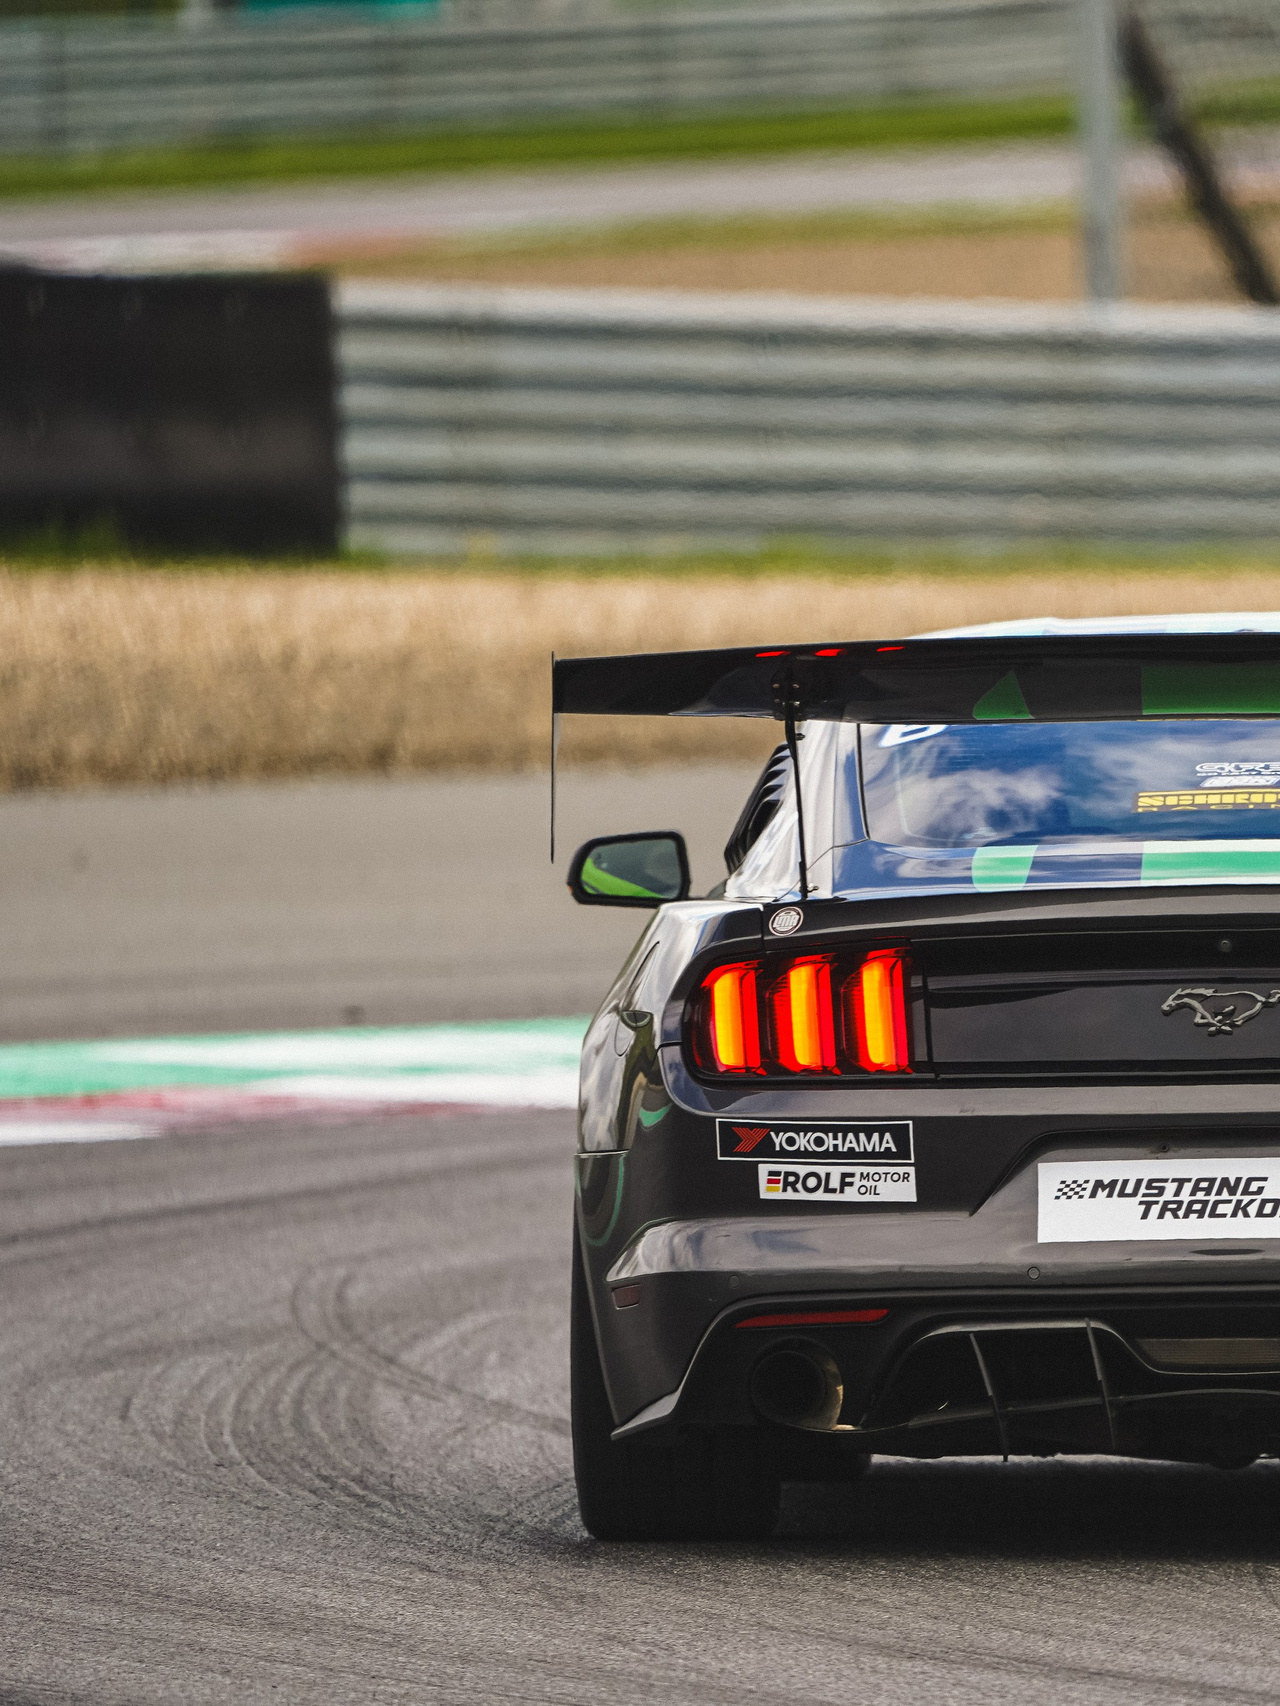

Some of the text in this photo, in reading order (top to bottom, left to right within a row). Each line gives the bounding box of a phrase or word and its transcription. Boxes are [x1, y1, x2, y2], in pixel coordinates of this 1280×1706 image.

[769, 1131, 898, 1152] YOKOHAMA
[781, 1171, 910, 1194] ROLF MOTOR
[857, 1184, 880, 1196] OIL
[1088, 1176, 1269, 1199] MUSTANG
